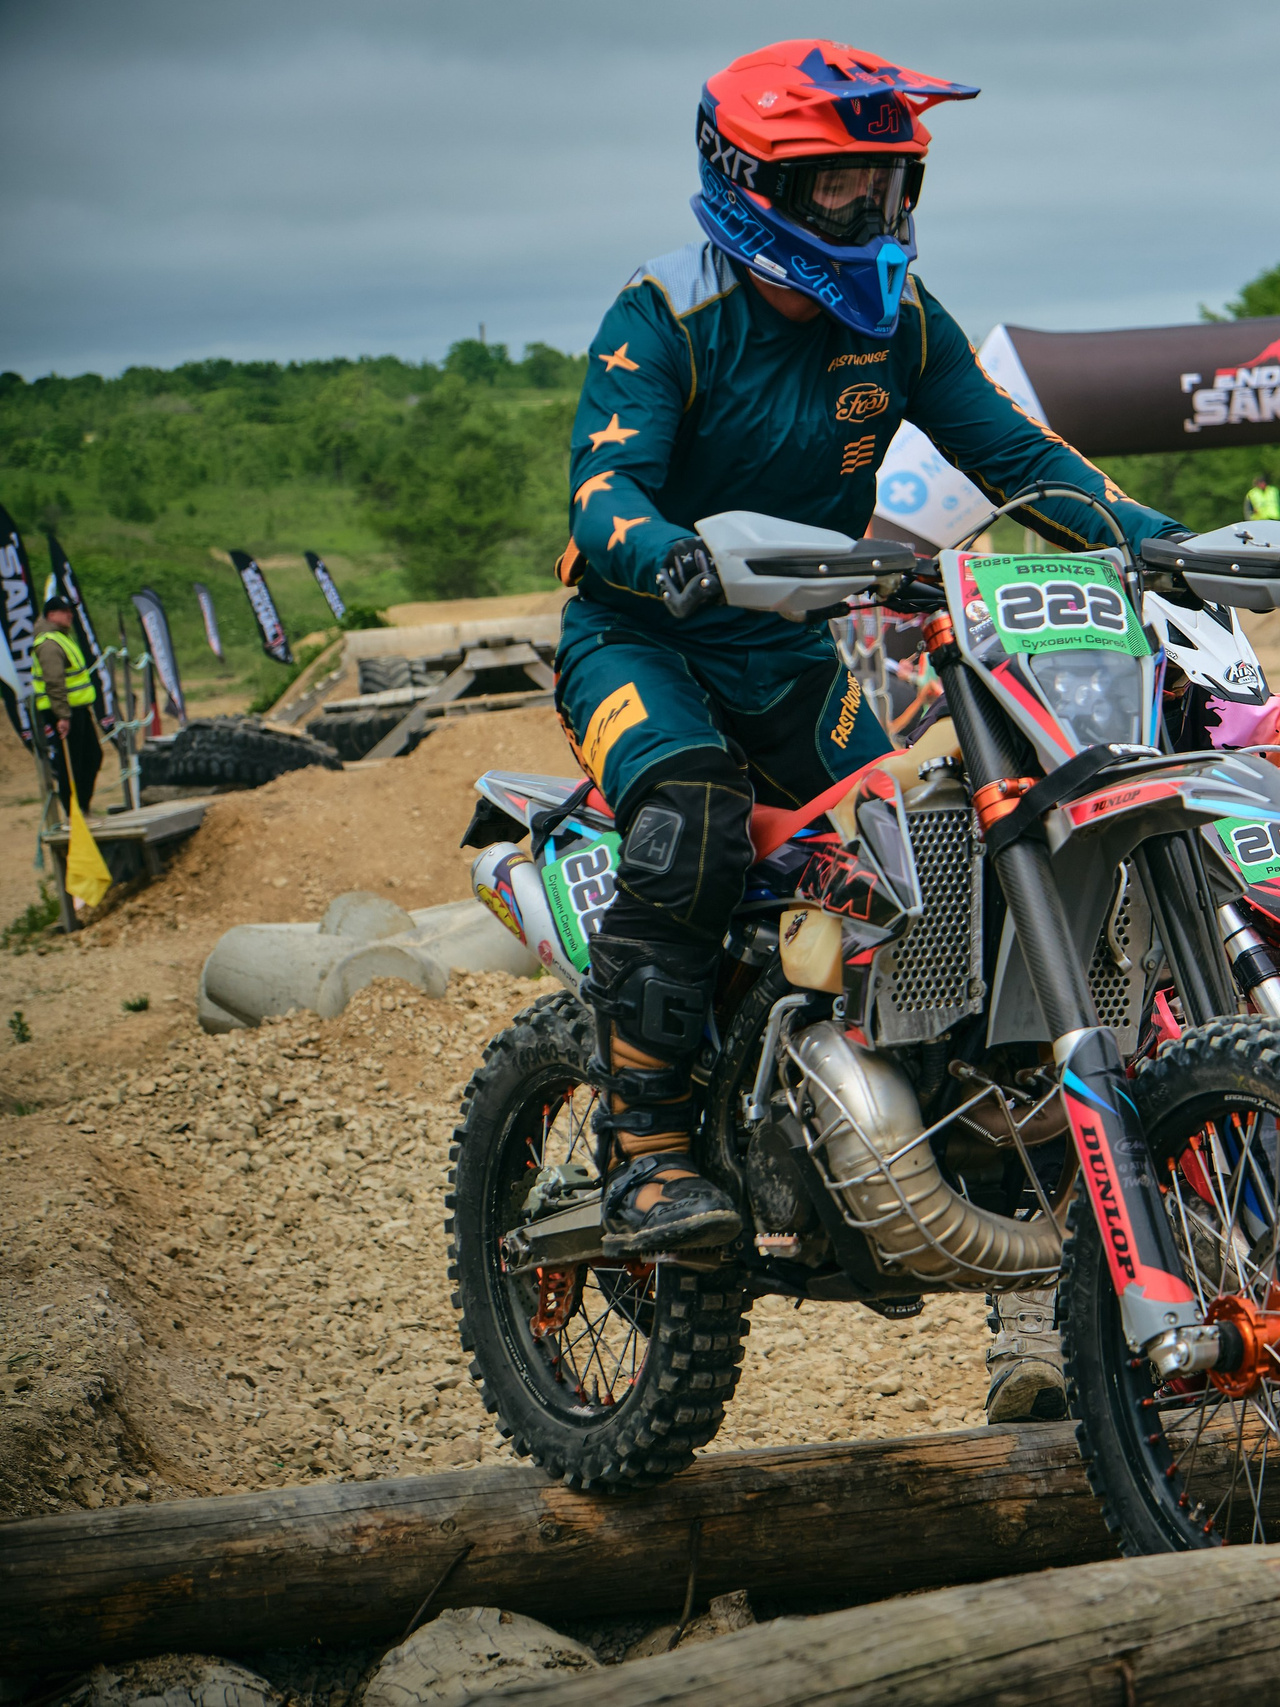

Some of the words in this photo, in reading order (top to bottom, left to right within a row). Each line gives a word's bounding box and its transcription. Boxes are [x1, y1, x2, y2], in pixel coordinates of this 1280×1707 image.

[699, 120, 759, 189] FXR
[995, 580, 1128, 634] 222
[1022, 635, 1082, 650] Сухович
[1085, 634, 1127, 649] Сергей
[1090, 790, 1141, 813] DUNLOP
[1257, 1098, 1267, 1108] X
[1080, 1124, 1137, 1280] DUNLOP
